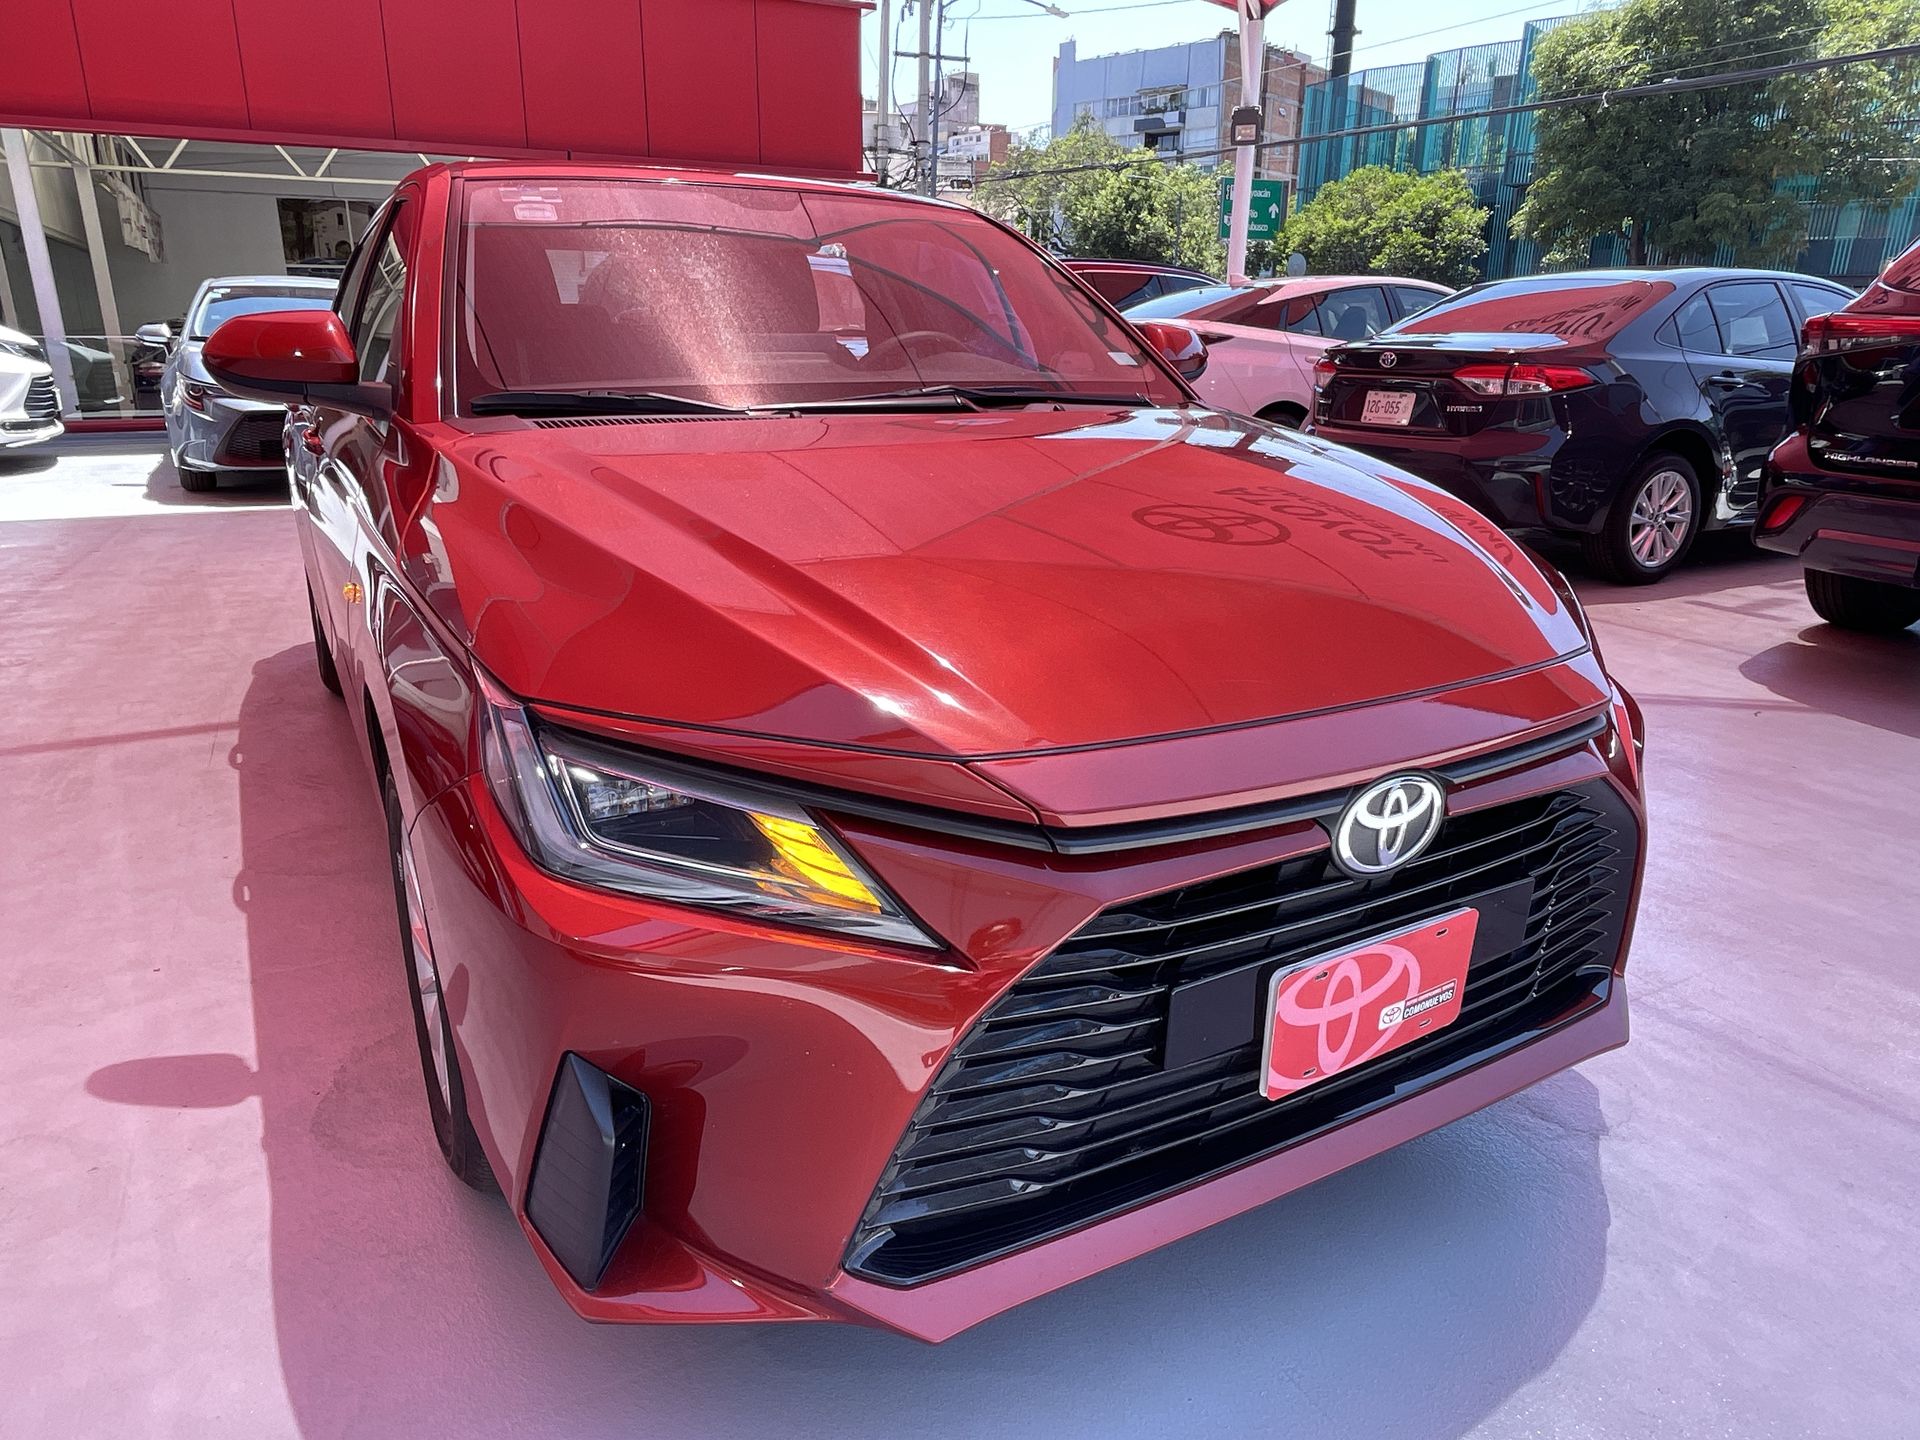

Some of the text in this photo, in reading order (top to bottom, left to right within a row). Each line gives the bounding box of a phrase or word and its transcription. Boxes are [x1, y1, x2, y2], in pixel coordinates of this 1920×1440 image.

[1250, 188, 1271, 199] yoacán
[1248, 221, 1269, 231] ubusco
[1824, 452, 1918, 468] HIGHLANDER
[1215, 487, 1415, 560] TOYOTA
